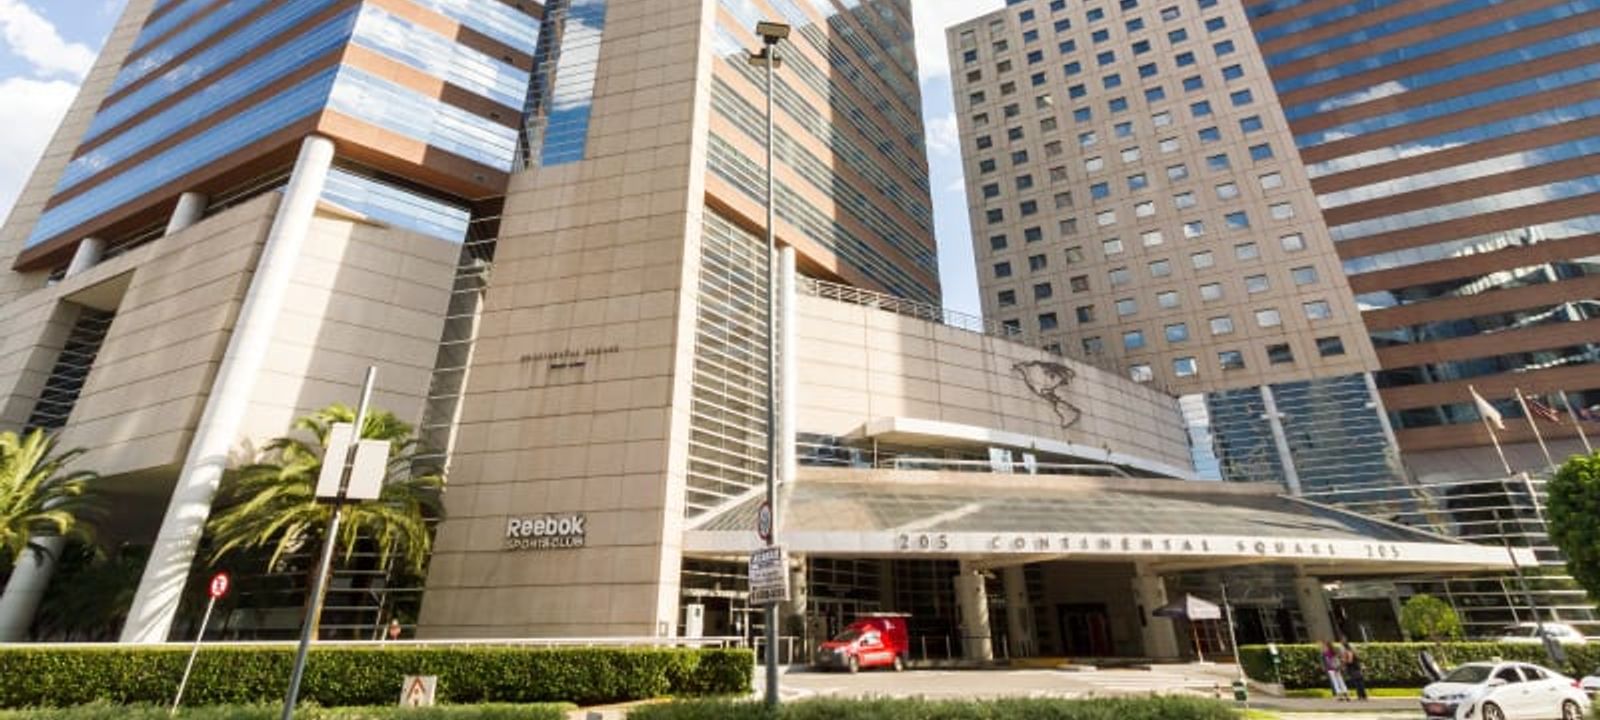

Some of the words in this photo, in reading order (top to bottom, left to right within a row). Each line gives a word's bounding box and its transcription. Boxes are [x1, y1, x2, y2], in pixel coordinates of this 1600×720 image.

[506, 516, 584, 537] Reebok
[898, 534, 948, 550] 205
[990, 536, 1209, 552] CONTINENTAL
